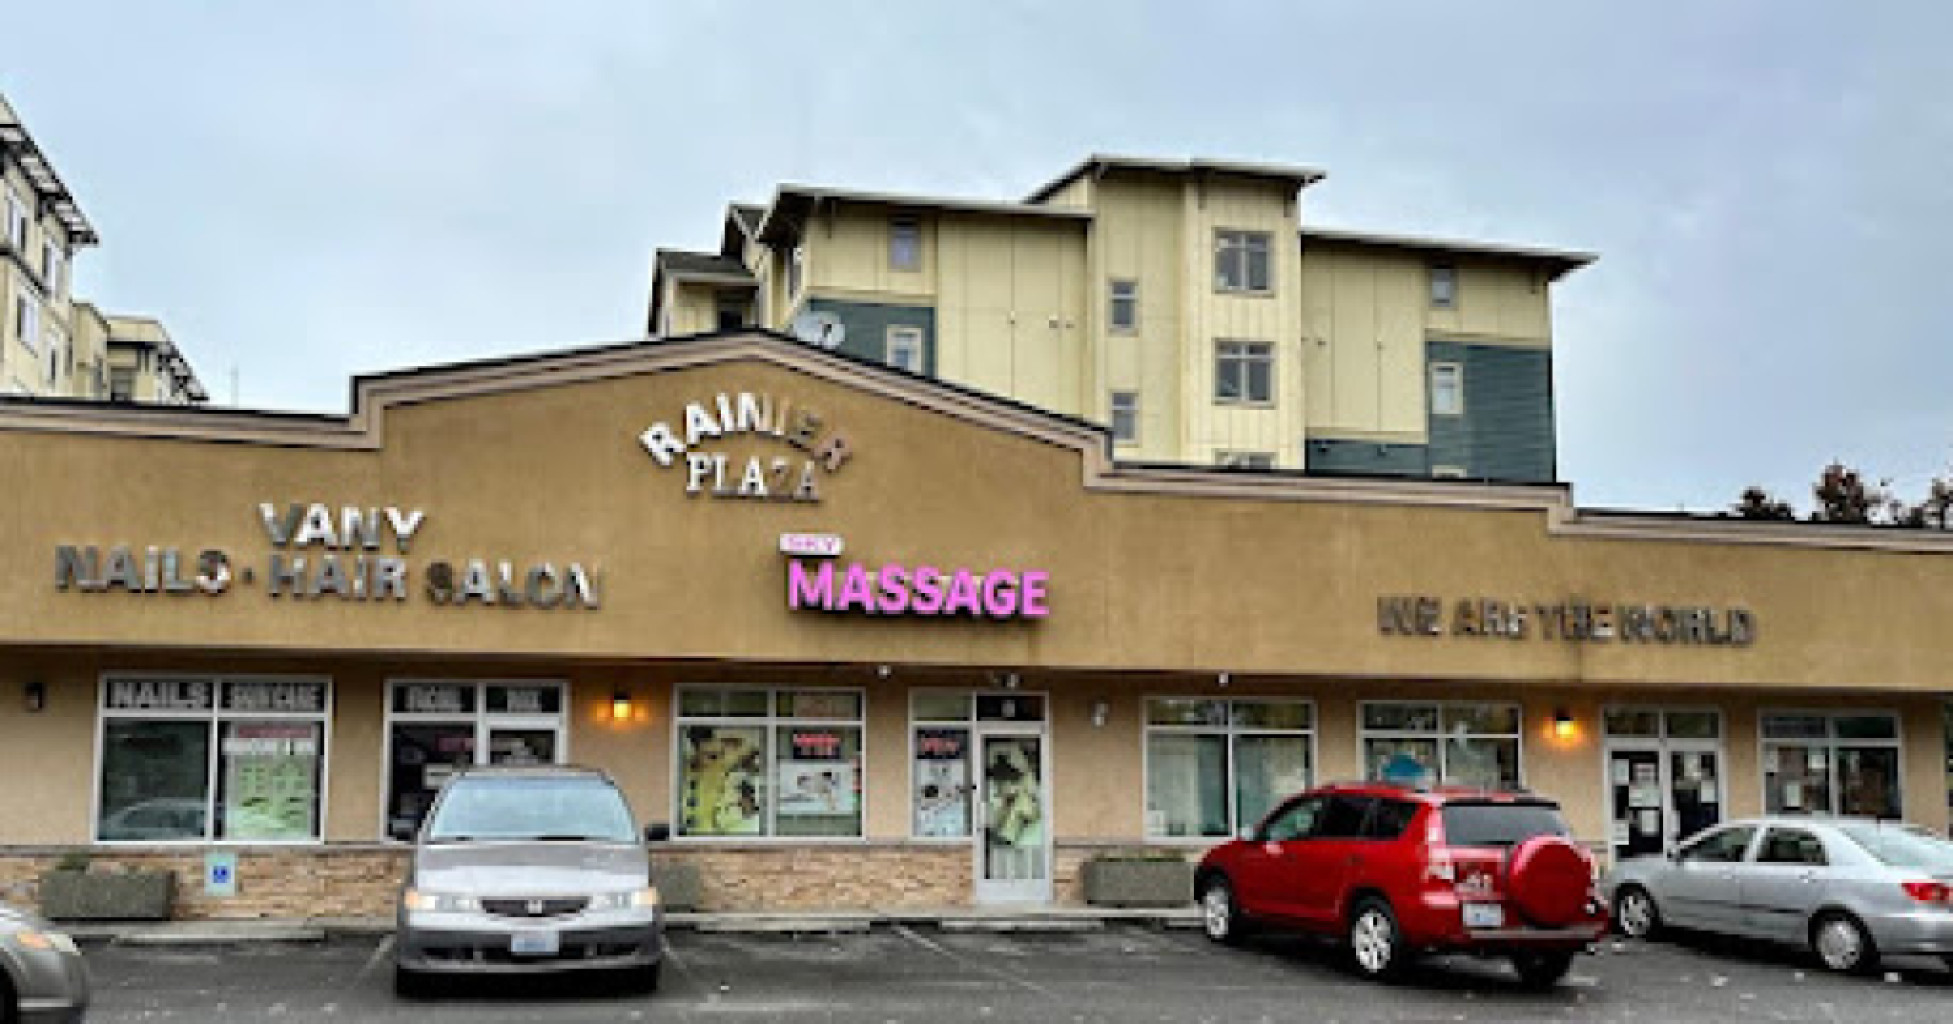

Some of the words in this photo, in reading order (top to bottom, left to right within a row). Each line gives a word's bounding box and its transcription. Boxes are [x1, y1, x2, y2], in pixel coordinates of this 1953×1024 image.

[640, 391, 854, 473] RAINIER
[686, 451, 822, 504] PLAZA
[259, 502, 425, 553] VANY
[56, 545, 232, 594] NAILS
[267, 554, 408, 602] HAIR
[426, 561, 603, 610] SALON
[788, 561, 1050, 619] MASSAGE
[1377, 595, 1444, 637] WE
[1617, 605, 1757, 648] WORLD
[111, 682, 208, 709] NAILS
